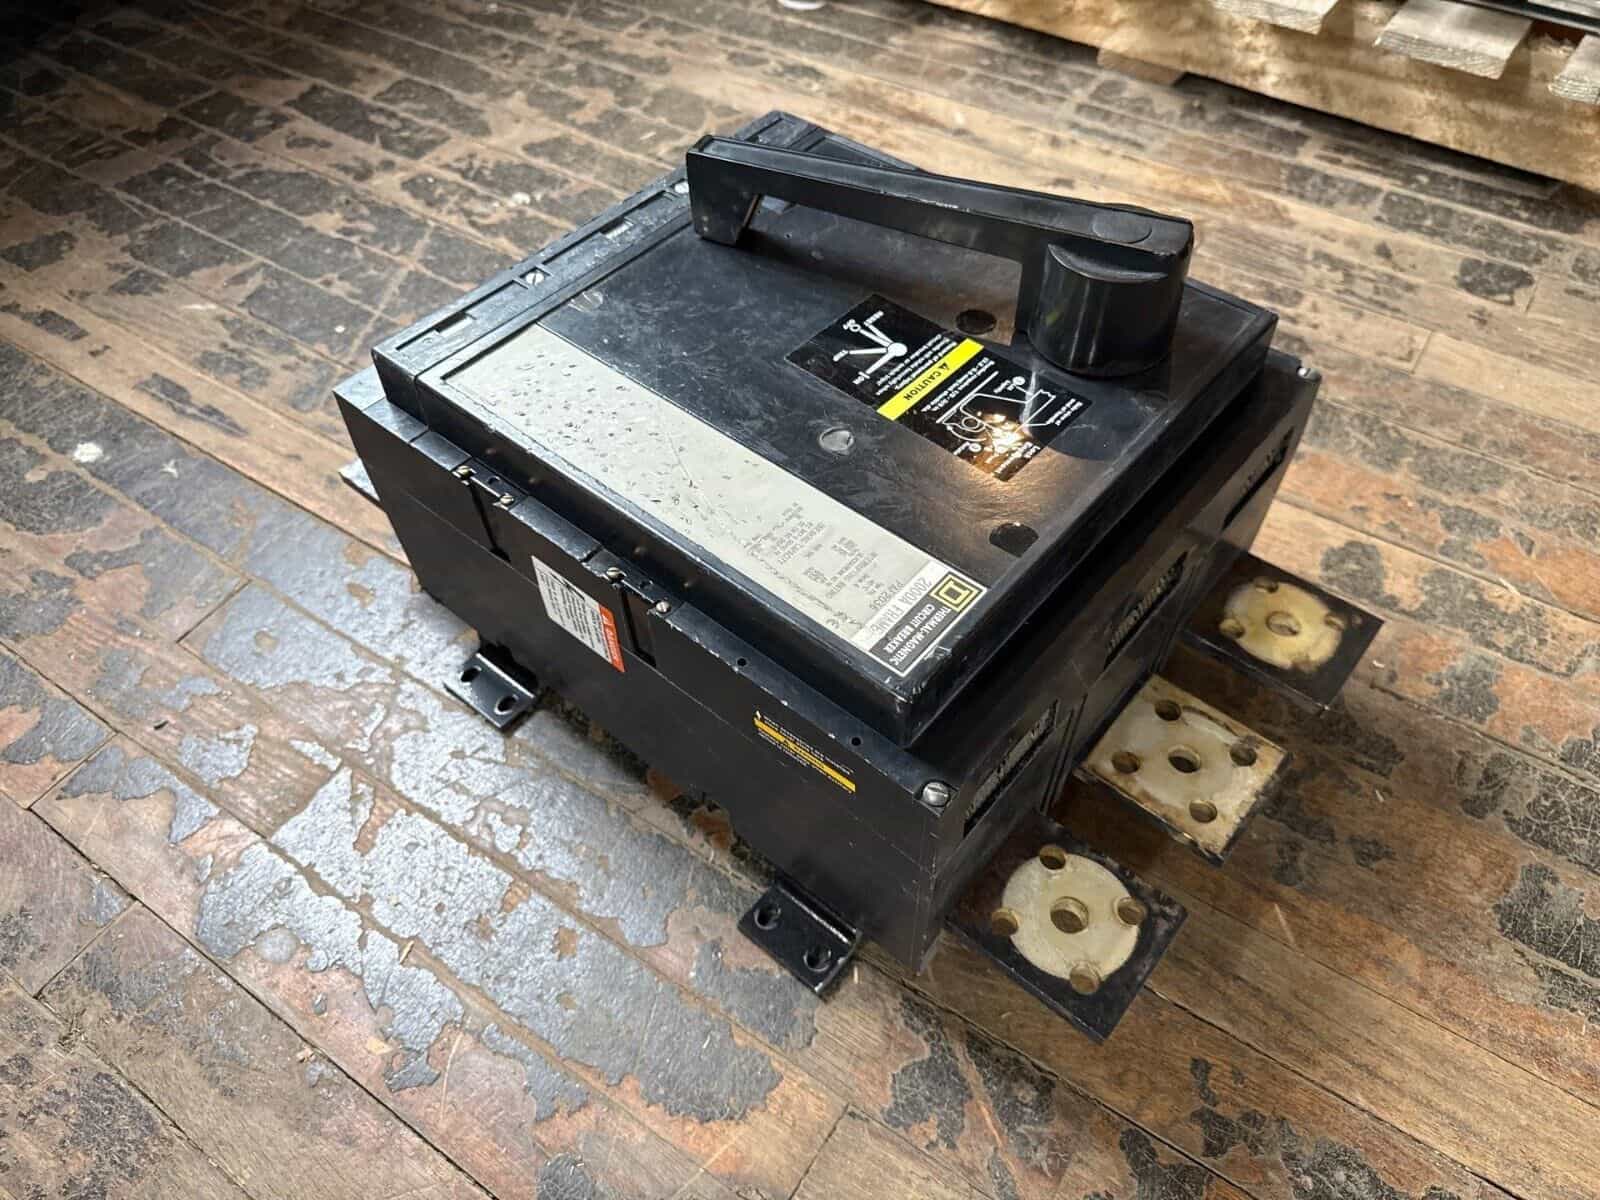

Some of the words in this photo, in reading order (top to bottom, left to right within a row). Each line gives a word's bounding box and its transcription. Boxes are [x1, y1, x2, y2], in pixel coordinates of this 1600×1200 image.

[902, 371, 942, 400] CAUTION
[898, 577, 932, 606] 2000A
[869, 605, 905, 635] FRAME
[911, 603, 935, 628] CIRCUIT
[883, 625, 914, 653] BREAKER
[890, 606, 951, 665] THERMAL-MAGNETIC
